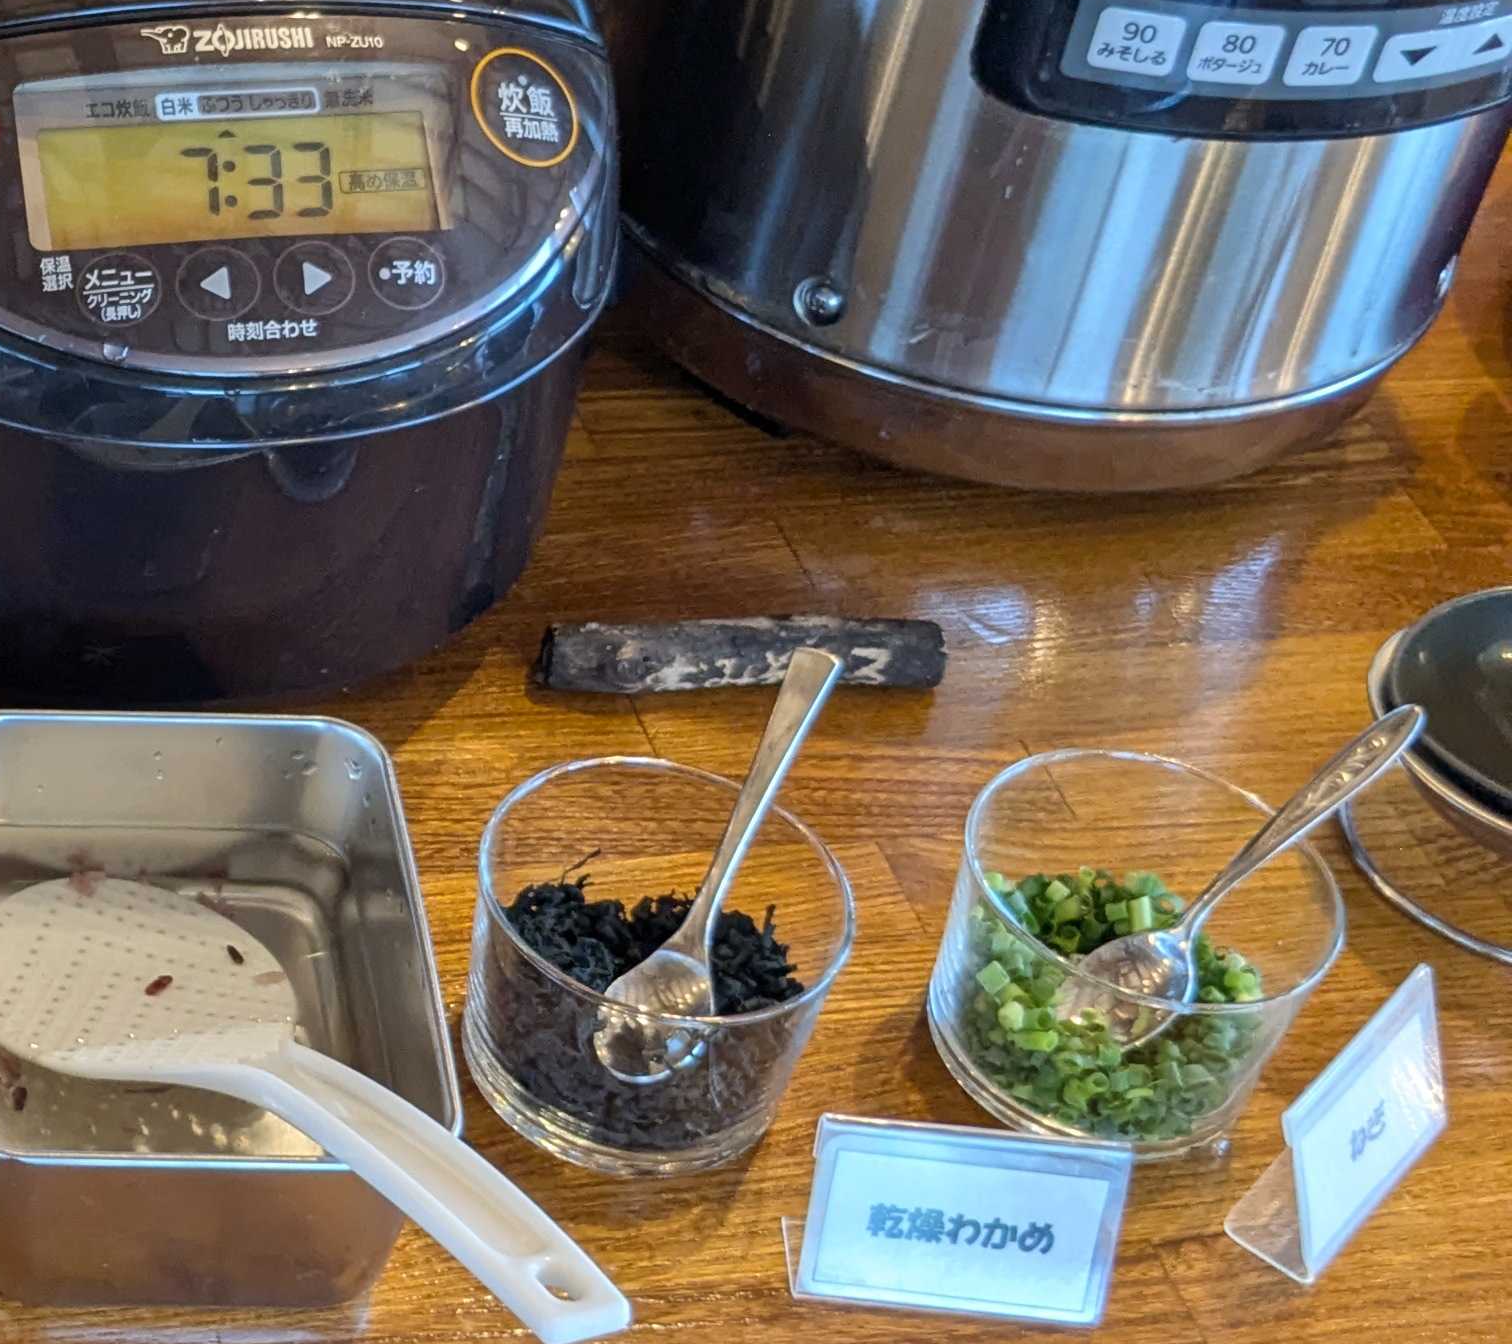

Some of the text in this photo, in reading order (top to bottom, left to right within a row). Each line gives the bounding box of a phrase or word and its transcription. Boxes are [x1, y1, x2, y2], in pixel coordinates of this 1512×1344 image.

[193, 24, 384, 56] ZOJIRUSHI NP-ZU10
[1123, 22, 1158, 44] 90
[1096, 42, 1168, 67] みそしる
[1222, 34, 1258, 55] 80
[1321, 37, 1352, 57] 70
[1302, 60, 1351, 76] カレー
[161, 94, 193, 117] 白米
[498, 86, 552, 117] 炊飯
[504, 114, 559, 143] 再加熱
[180, 141, 334, 220] 7:33
[40, 257, 71, 274] 保温
[392, 261, 436, 286] 予約
[42, 273, 74, 292] 選択
[85, 268, 152, 288] メニュー
[87, 290, 152, 309] クリーニング
[100, 304, 141, 323] (長押し)
[228, 320, 319, 341] 時刻合わせ
[867, 1203, 1056, 1255] 乾燥わかめ
